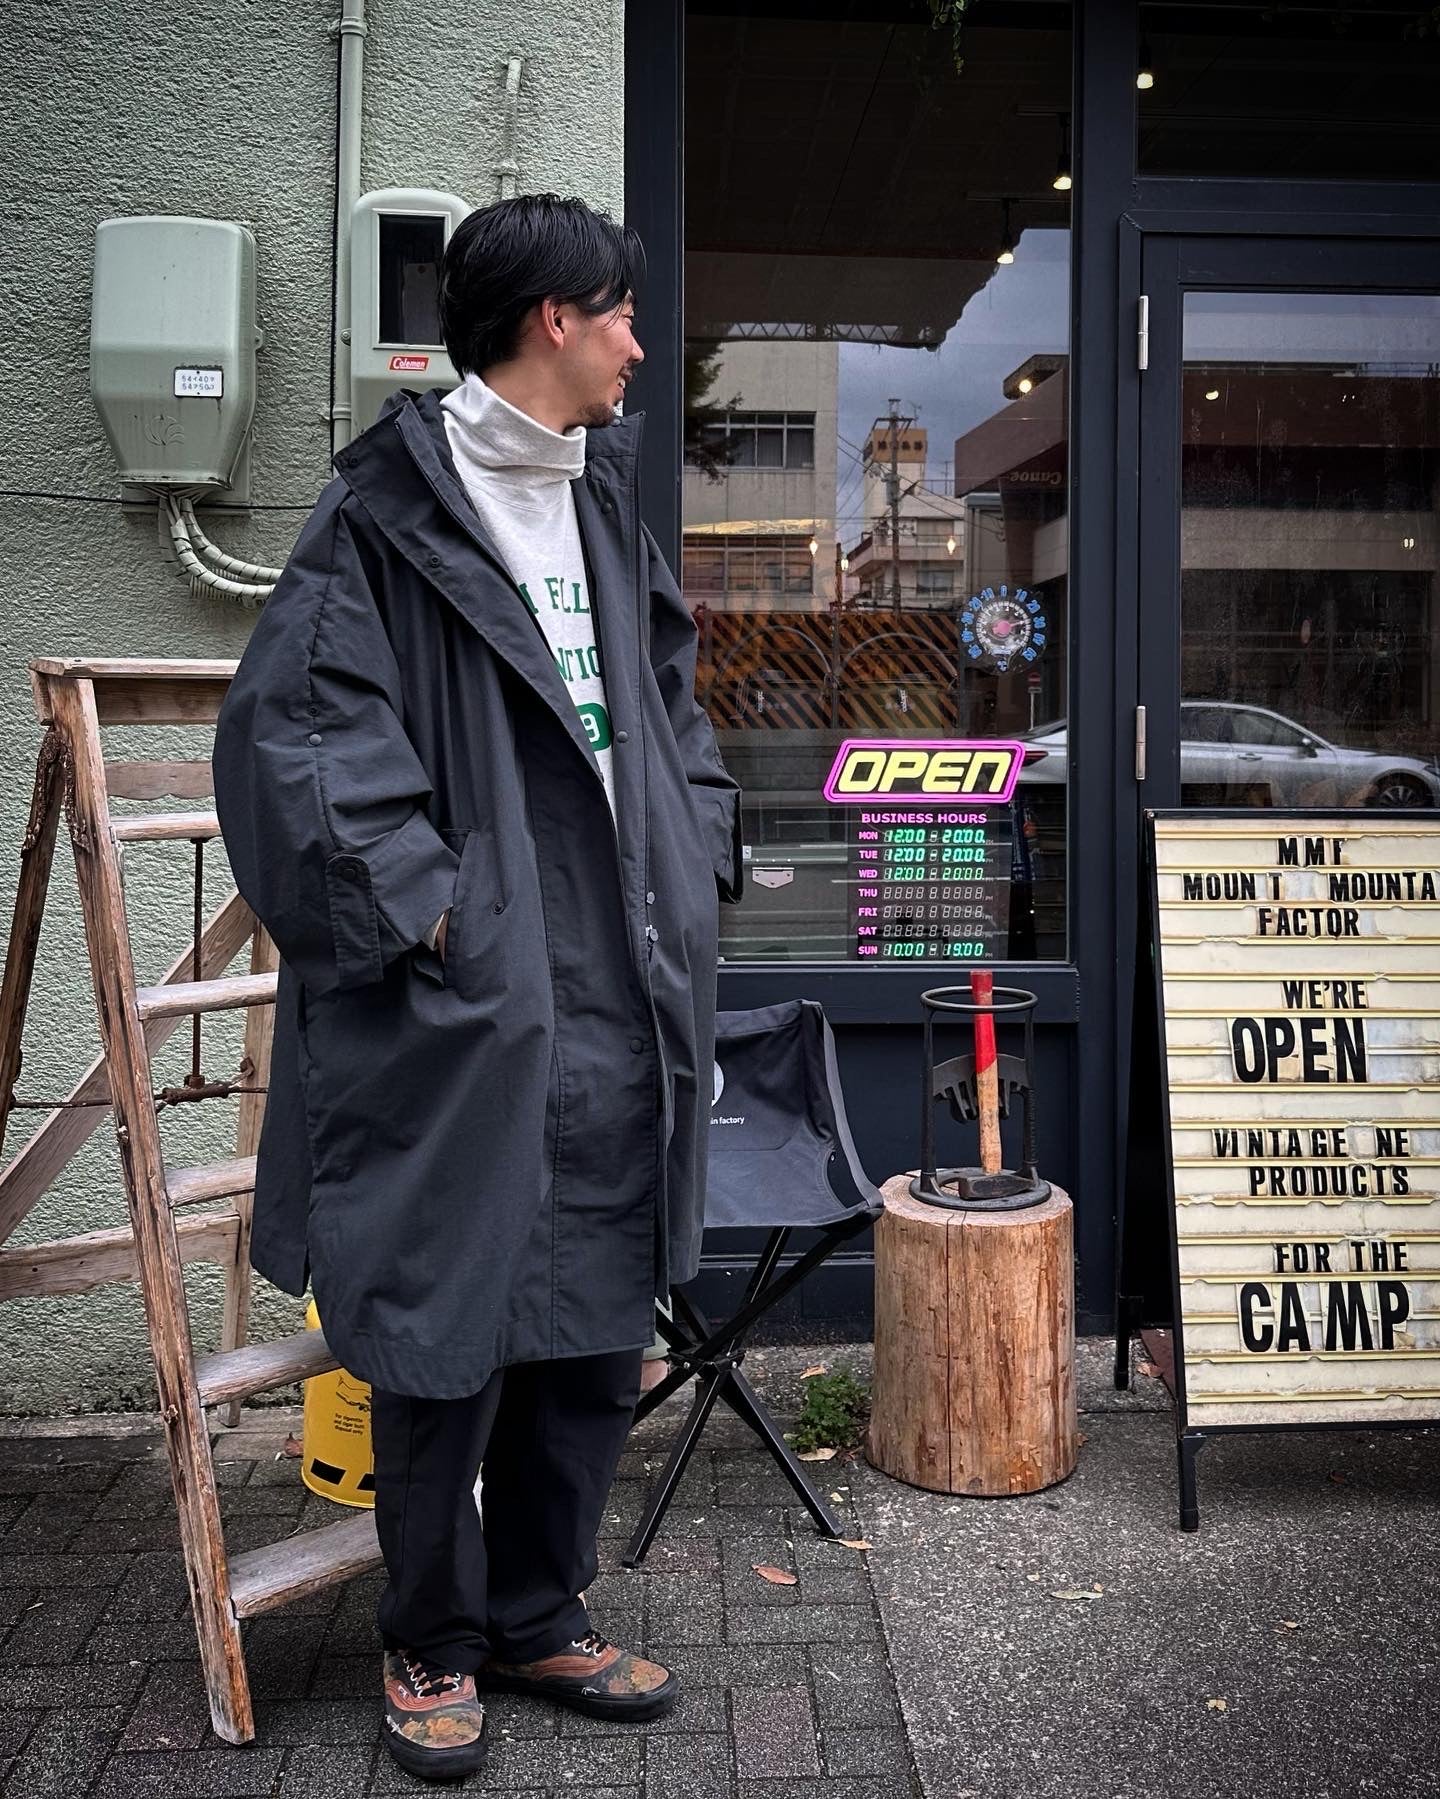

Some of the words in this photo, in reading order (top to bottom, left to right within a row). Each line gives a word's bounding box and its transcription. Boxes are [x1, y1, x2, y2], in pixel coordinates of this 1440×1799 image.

[392, 357, 426, 369] Coleman
[838, 751, 1012, 792] OPEN
[861, 813, 934, 824] BUSINESS
[937, 813, 987, 824] HOURS
[858, 831, 878, 840] MON
[858, 850, 878, 859] TUE
[858, 869, 878, 878] WED
[858, 888, 878, 897] THU
[1329, 873, 1436, 900] MOUNTA
[858, 907, 878, 917] FRI
[1259, 908, 1360, 936] FACTOR
[858, 927, 878, 936] SAT
[858, 945, 878, 955] SUN
[1282, 981, 1367, 1008] WE'RE
[1231, 1017, 1367, 1083] OPEN
[719, 1116, 745, 1126] factory
[1214, 1128, 1347, 1157] VINTAGE
[1376, 1128, 1409, 1157] NE
[1250, 1165, 1409, 1197] PRODUCTS
[1275, 1242, 1332, 1273] FOR
[1351, 1241, 1408, 1272] THE
[1239, 1281, 1410, 1352] CAMP
